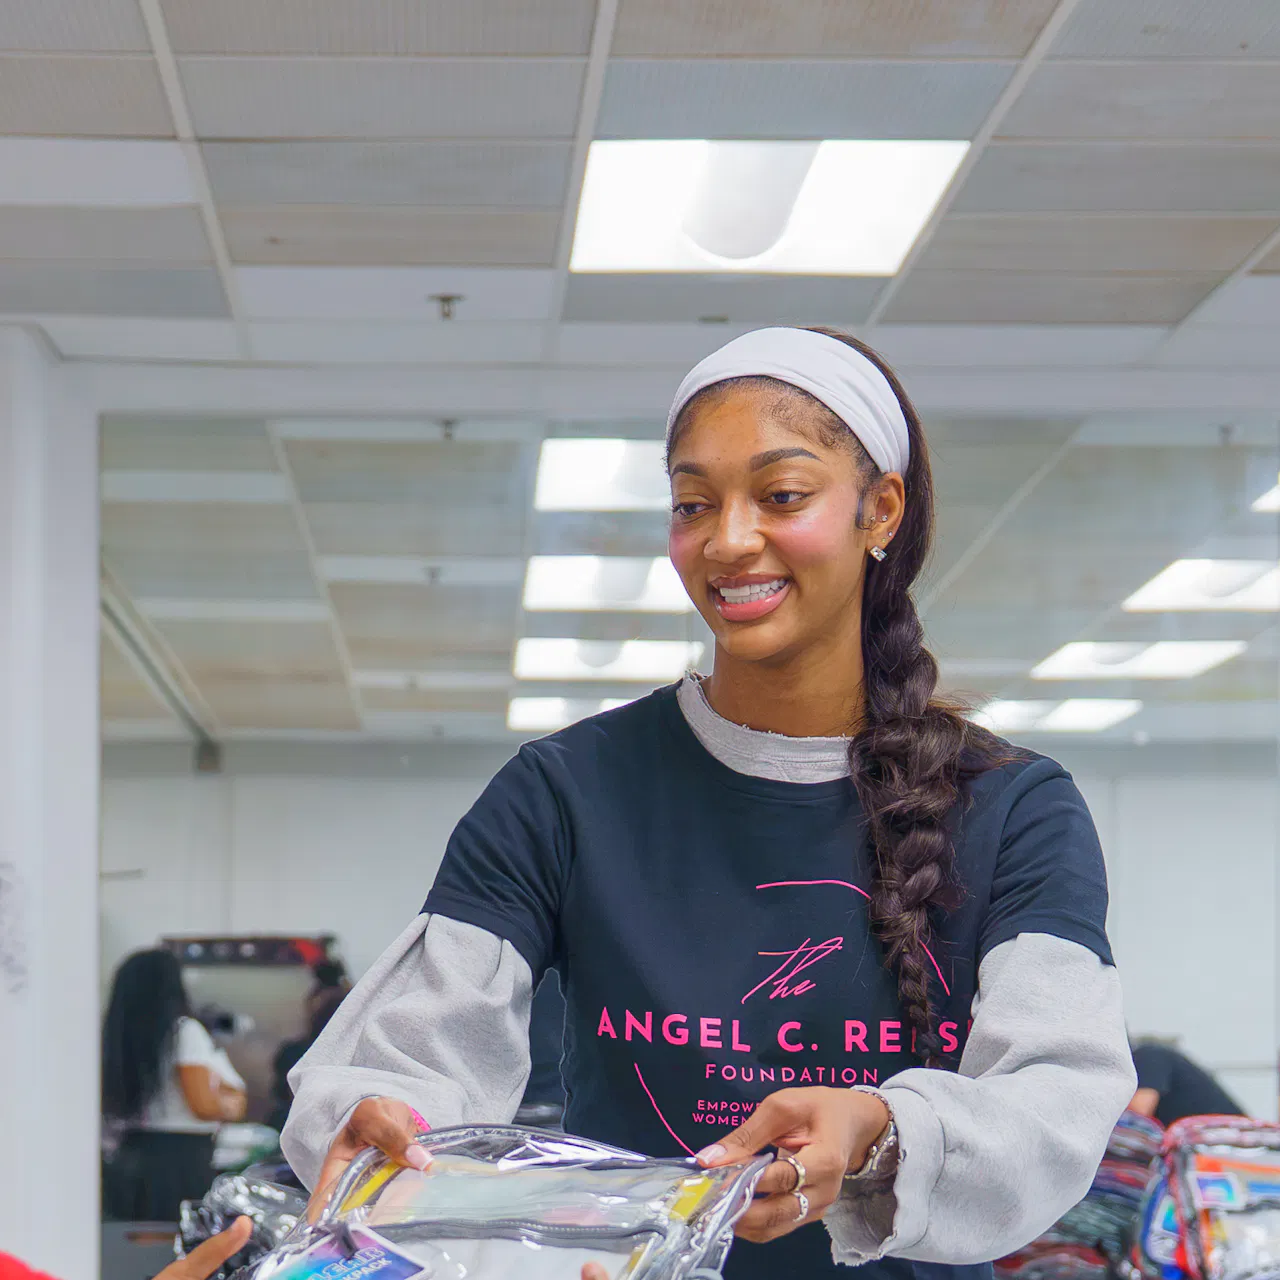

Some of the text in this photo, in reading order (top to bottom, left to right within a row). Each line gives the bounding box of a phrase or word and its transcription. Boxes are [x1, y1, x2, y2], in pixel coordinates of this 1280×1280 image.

[597, 1007, 973, 1053] ANGEL C. RES
[705, 1063, 879, 1084] FOUNDATION
